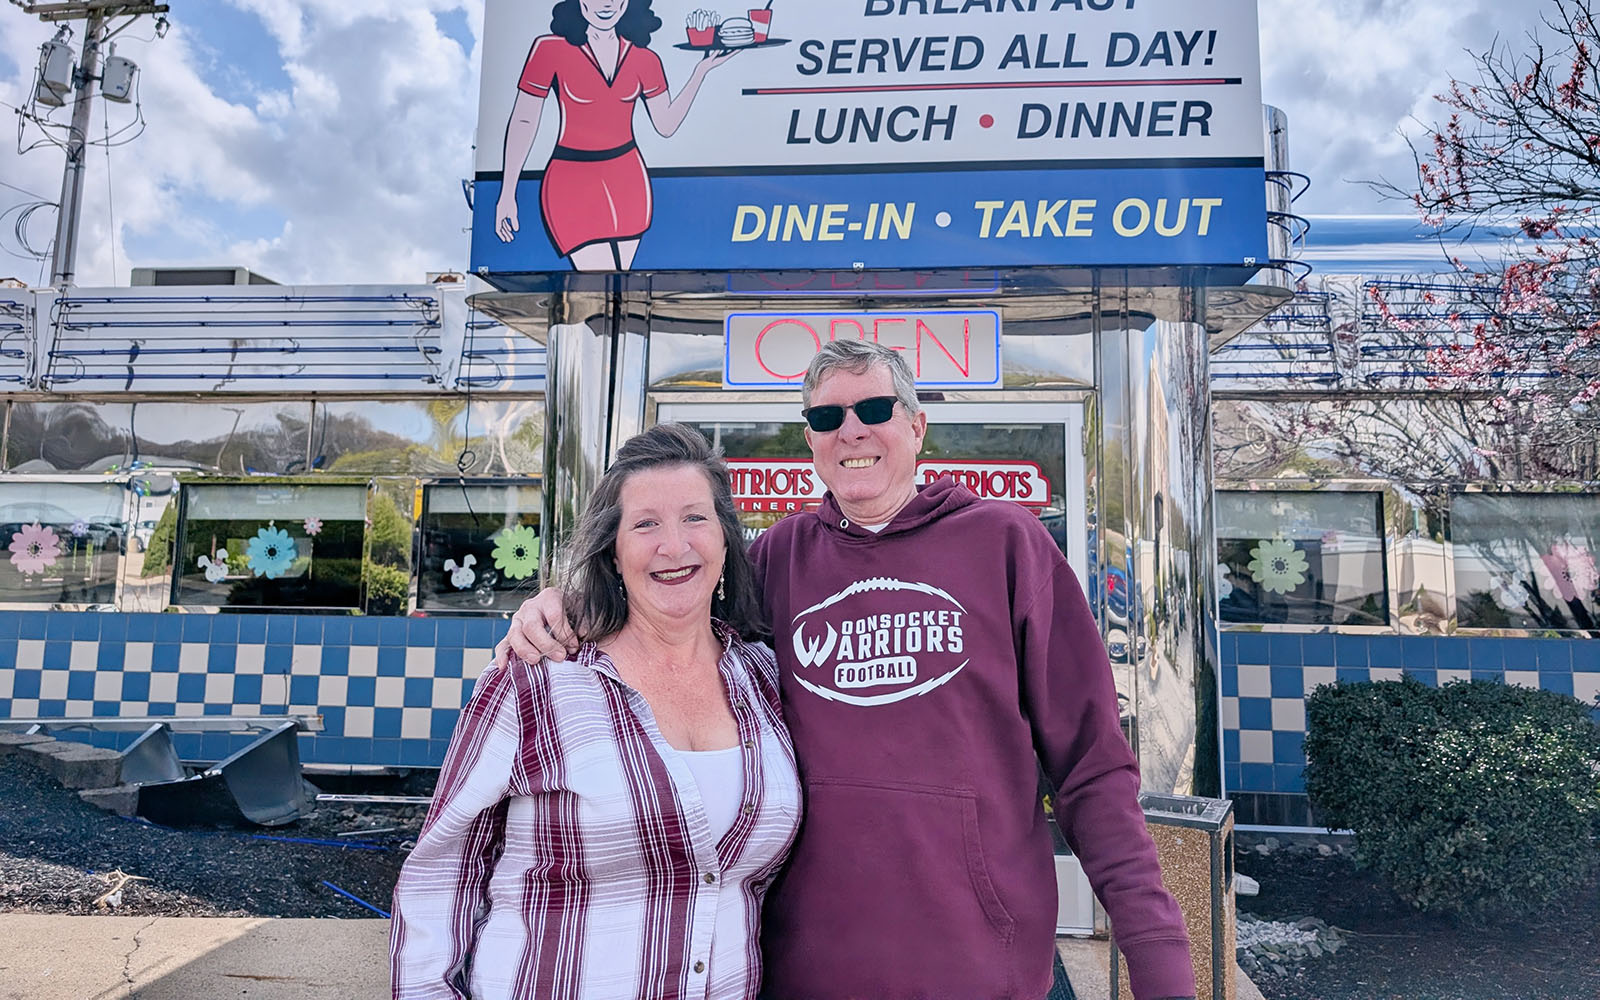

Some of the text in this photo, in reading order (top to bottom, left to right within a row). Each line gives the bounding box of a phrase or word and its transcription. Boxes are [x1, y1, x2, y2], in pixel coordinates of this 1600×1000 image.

[796, 30, 1217, 76] SERVED ALL DAY!
[786, 100, 1213, 145] LUNCH DINNER
[731, 198, 1222, 242] DINE-IN TAKE OUT
[837, 661, 914, 683] FOOTBALL
